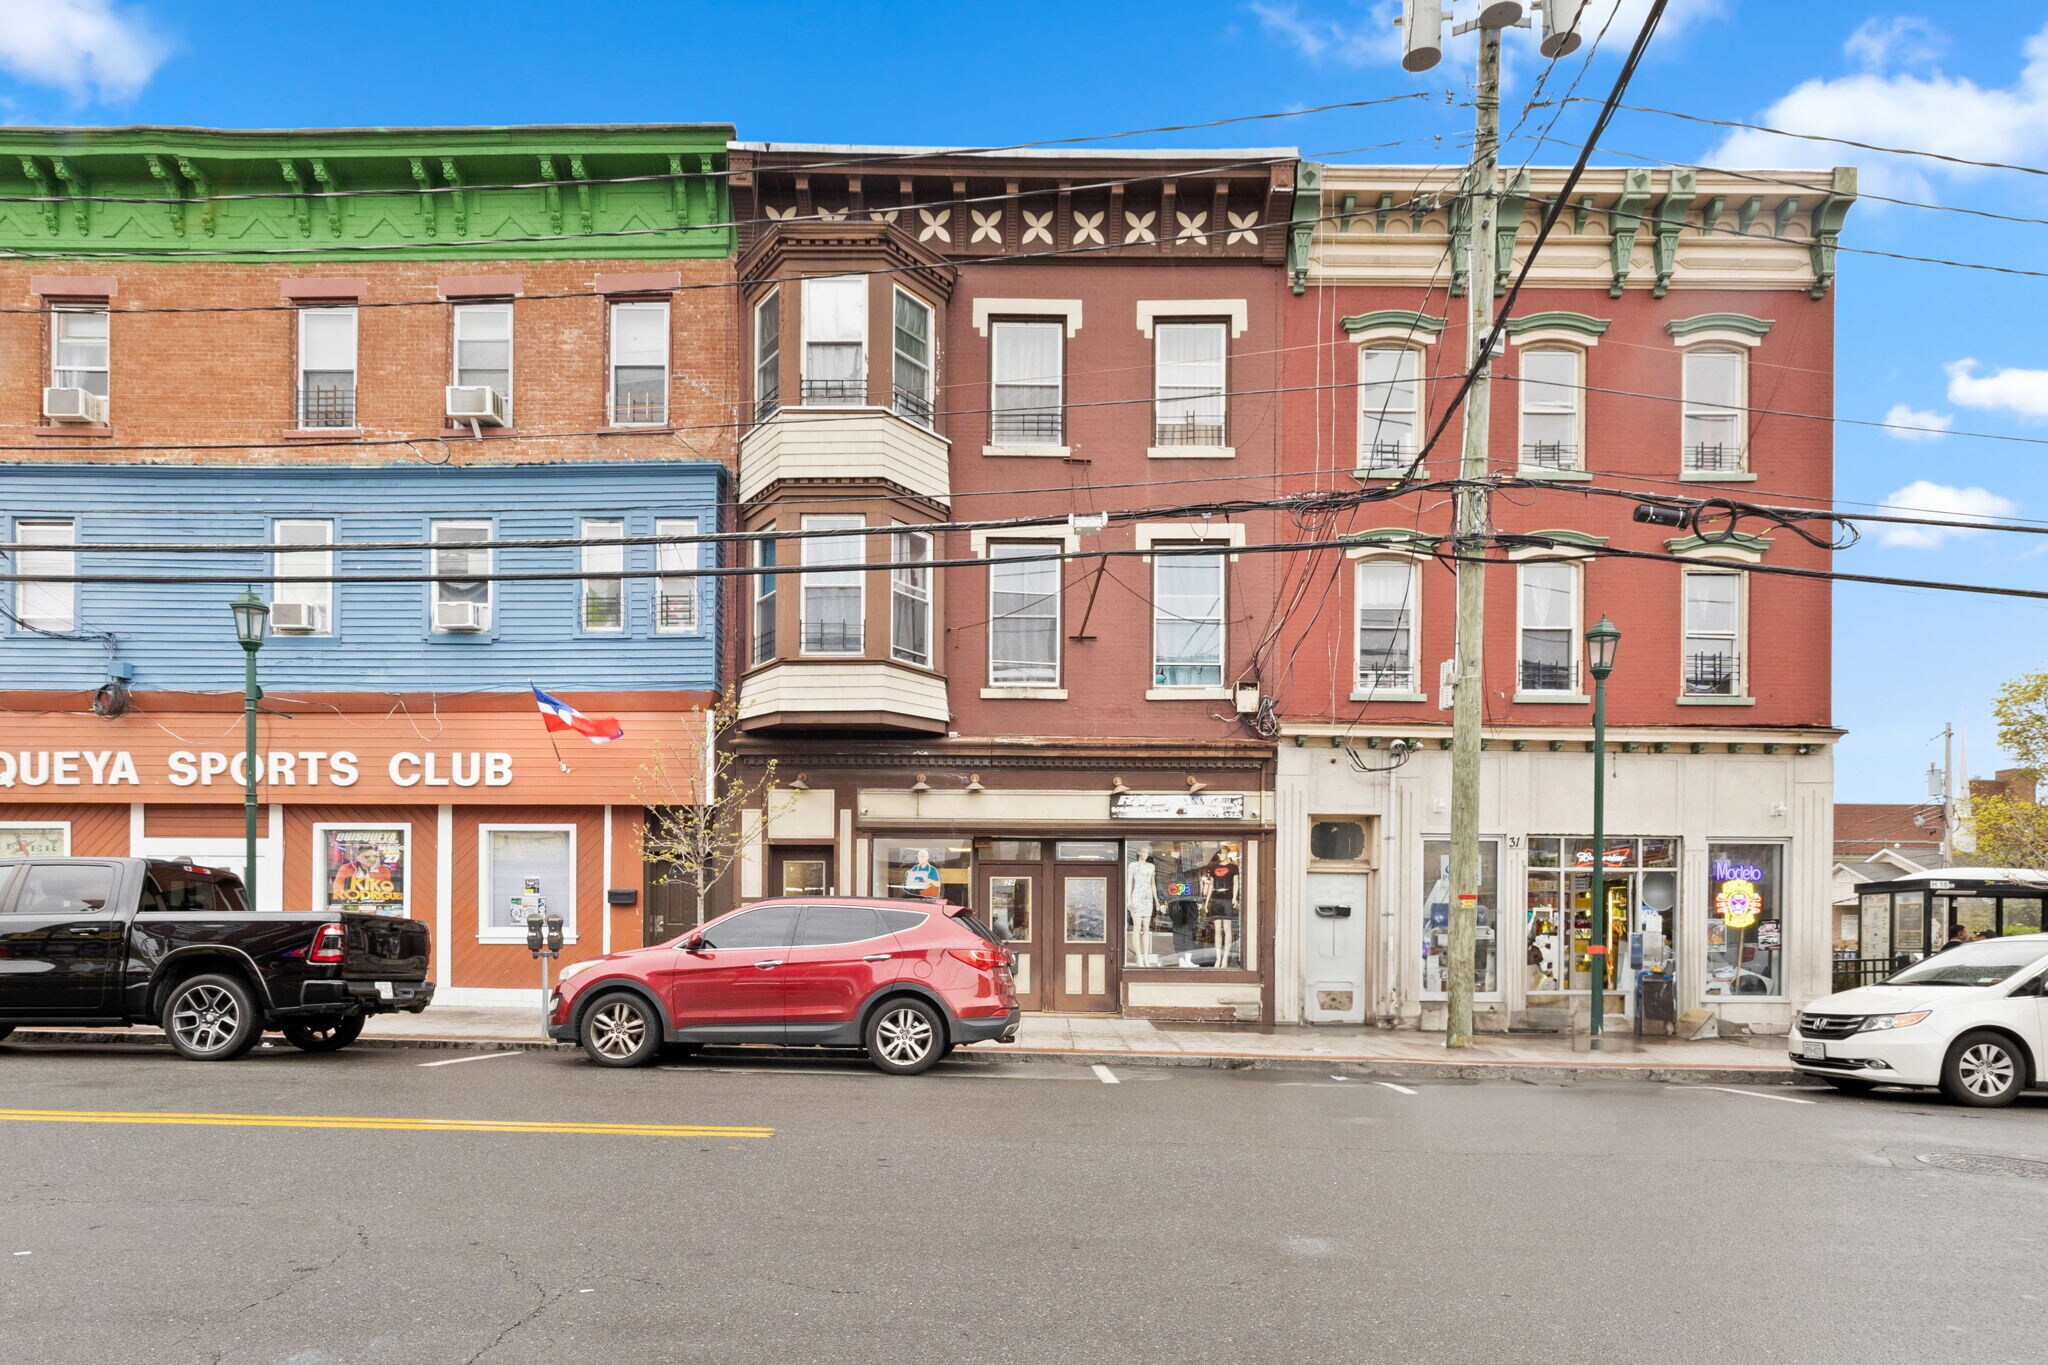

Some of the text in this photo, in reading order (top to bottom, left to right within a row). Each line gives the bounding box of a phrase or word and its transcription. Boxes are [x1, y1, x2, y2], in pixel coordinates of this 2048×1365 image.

[167, 750, 359, 787] SPORTS
[388, 751, 513, 787] CLUB
[1508, 836, 1521, 848] 31
[1716, 861, 1762, 881] Modelo
[350, 876, 395, 892] KIKO
